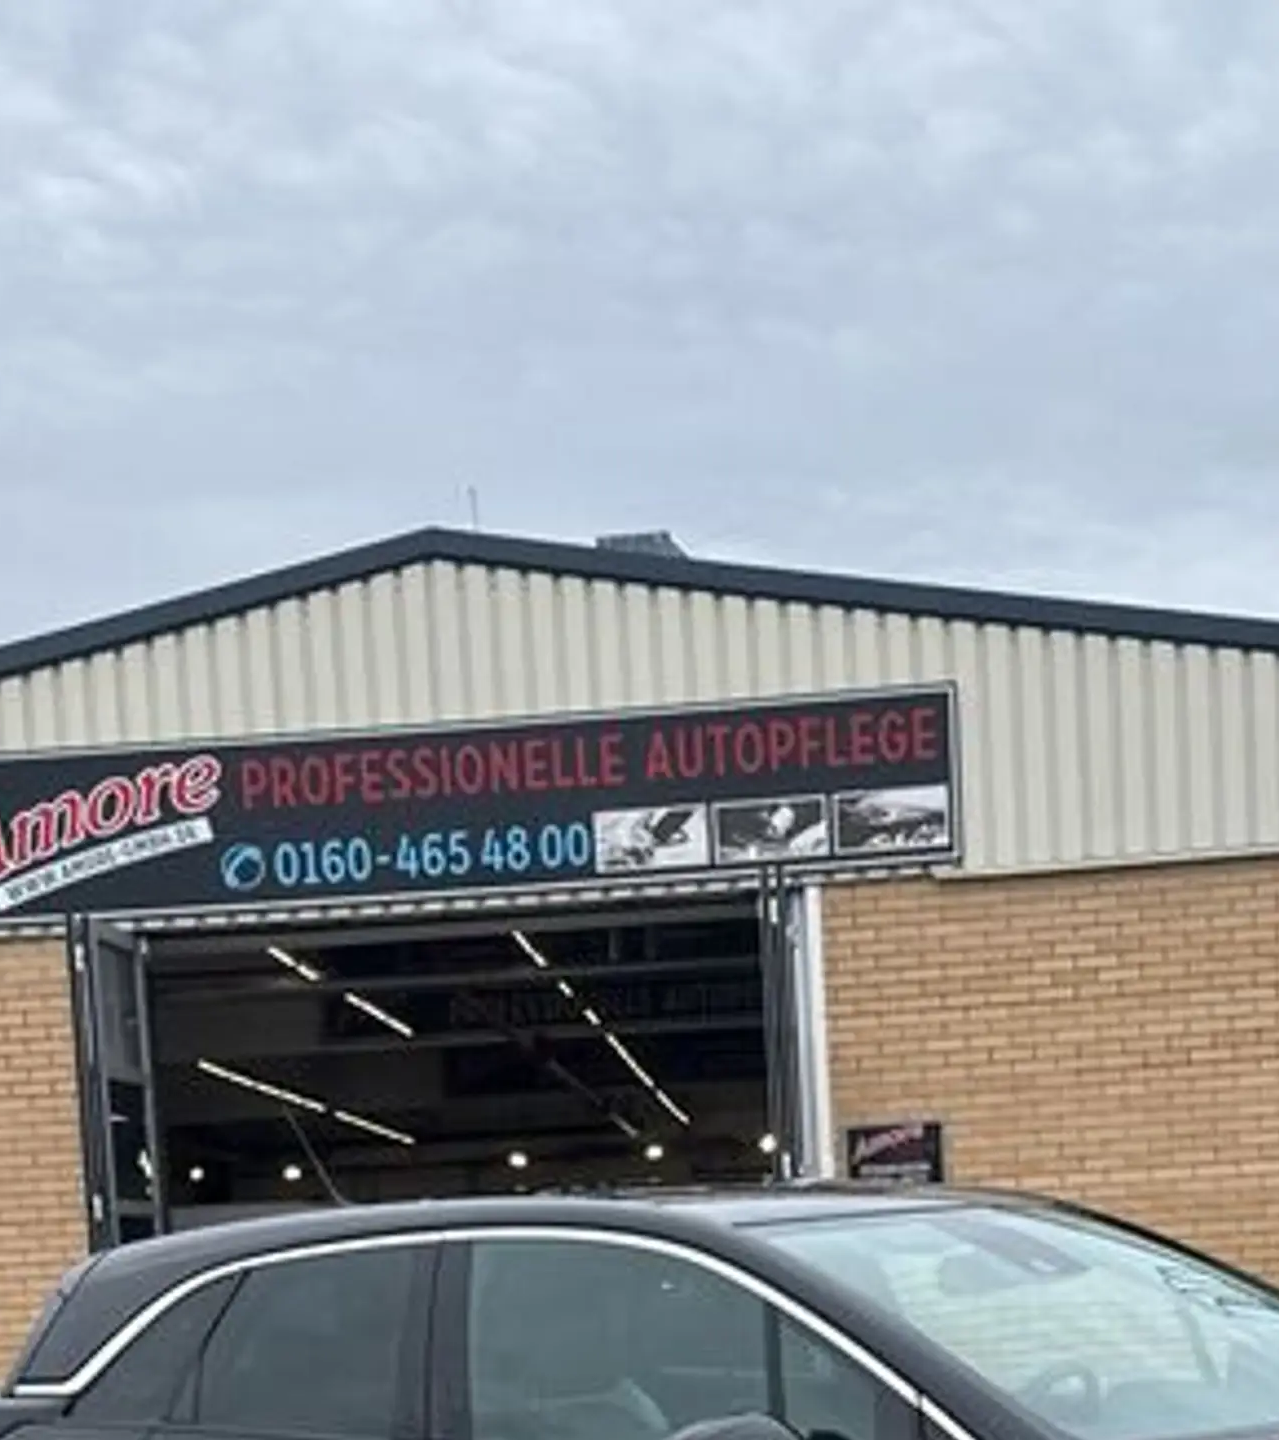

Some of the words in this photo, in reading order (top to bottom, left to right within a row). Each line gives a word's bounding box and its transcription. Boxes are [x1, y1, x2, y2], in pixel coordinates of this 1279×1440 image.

[240, 734, 626, 810] PROFESSIONELLE
[646, 707, 938, 780] AUTOPFLEGE
[273, 829, 471, 887] 0160-465
[480, 825, 531, 872] 48
[538, 822, 590, 869] 00
